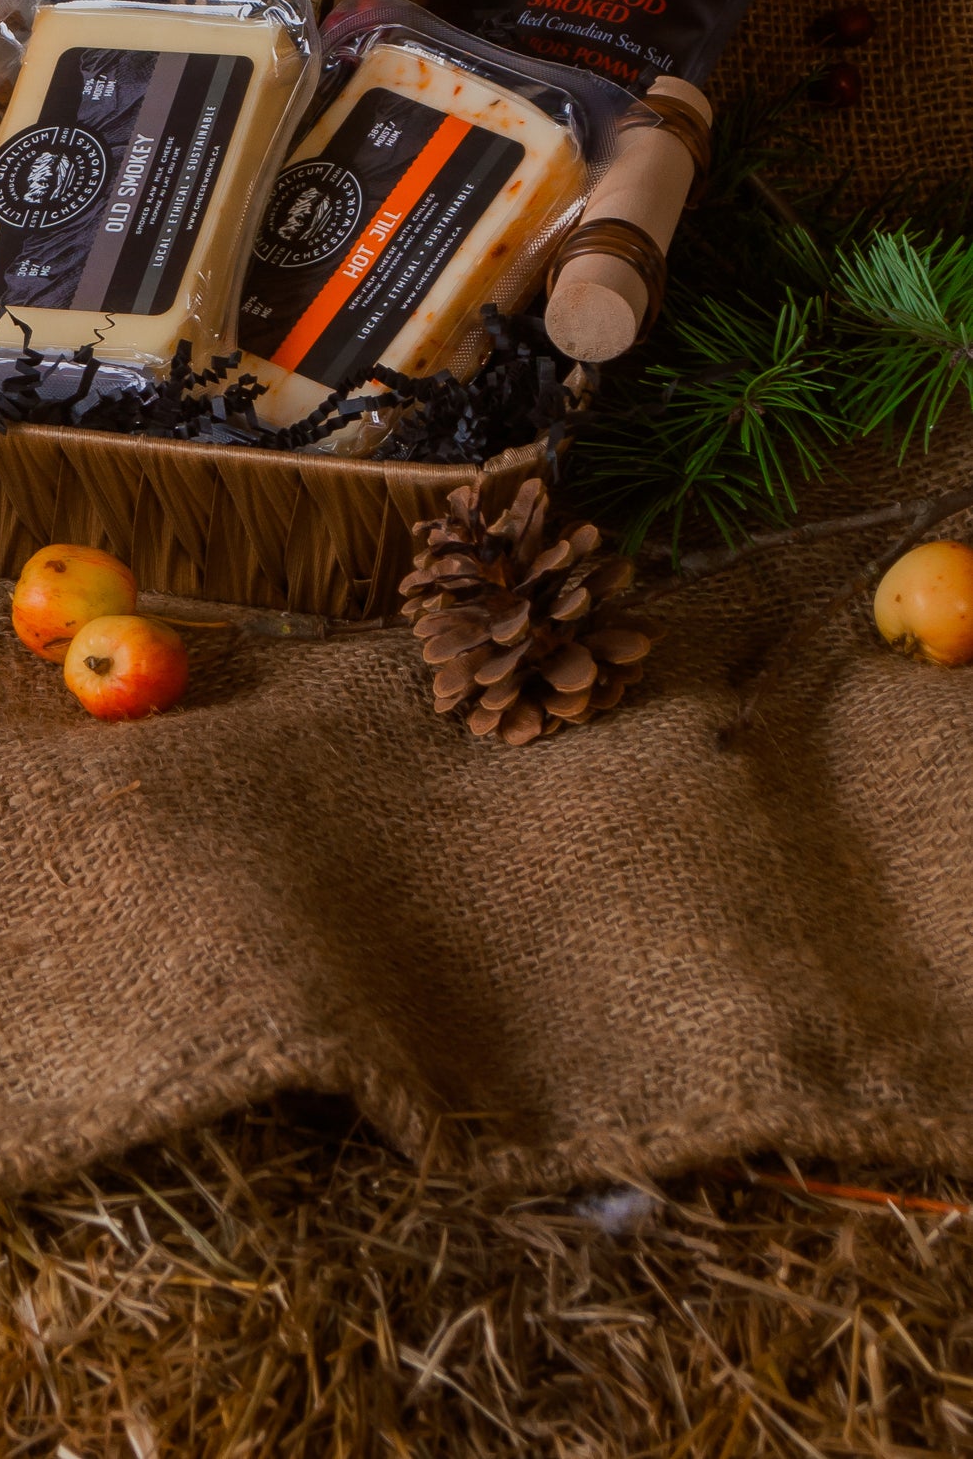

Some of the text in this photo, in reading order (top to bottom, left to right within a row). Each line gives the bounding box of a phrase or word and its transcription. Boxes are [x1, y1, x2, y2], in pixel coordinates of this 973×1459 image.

[546, 14, 613, 44] Canadian
[615, 33, 642, 55] Sea
[643, 46, 675, 72] Salt
[574, 46, 639, 83] POMM
[367, 122, 384, 140] 38%
[50, 137, 101, 220] CHEESEWORKS
[105, 133, 155, 233] OLD SMOKEY
[135, 135, 176, 235] SMOKED RAW MILK CHEESE
[153, 105, 217, 268] LOCAL ETHICAL SUSTAINABLE
[185, 145, 222, 231] WWW.CHEESEWORKS.CA
[270, 166, 324, 198] UALICUM
[292, 181, 357, 262] CHEESEWORKS
[342, 211, 403, 280] HOT JILL
[347, 192, 436, 311] SEMI-FIRM CHEESE WITH CHILLIES
[357, 182, 475, 341] LOCAL ETHICAL SUSTAINABLE
[17, 259, 31, 277] 30%
[39, 265, 52, 277] MG
[399, 225, 464, 310] WWW.CHEESEWORKS.CA
